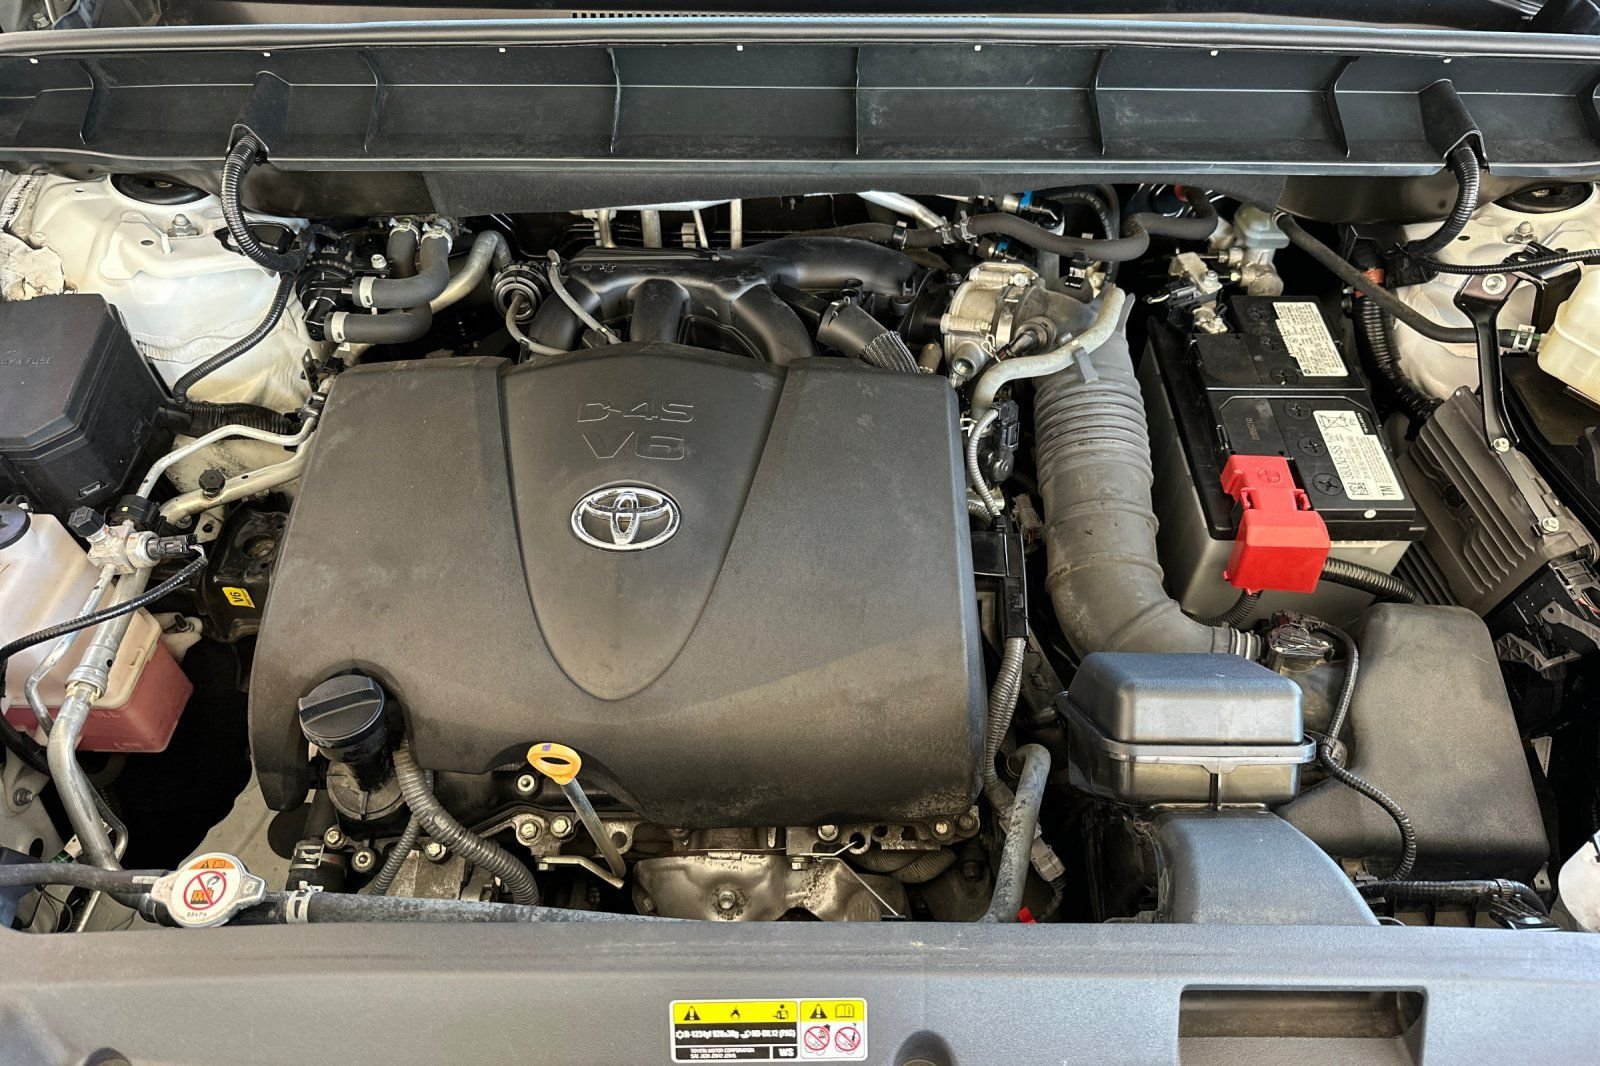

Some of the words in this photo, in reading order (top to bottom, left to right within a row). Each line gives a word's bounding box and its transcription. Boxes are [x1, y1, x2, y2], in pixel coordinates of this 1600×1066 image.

[26, 357, 54, 365] FUSE
[578, 402, 694, 422] D-4S
[582, 431, 685, 460] V6
[778, 1047, 794, 1056] WS
